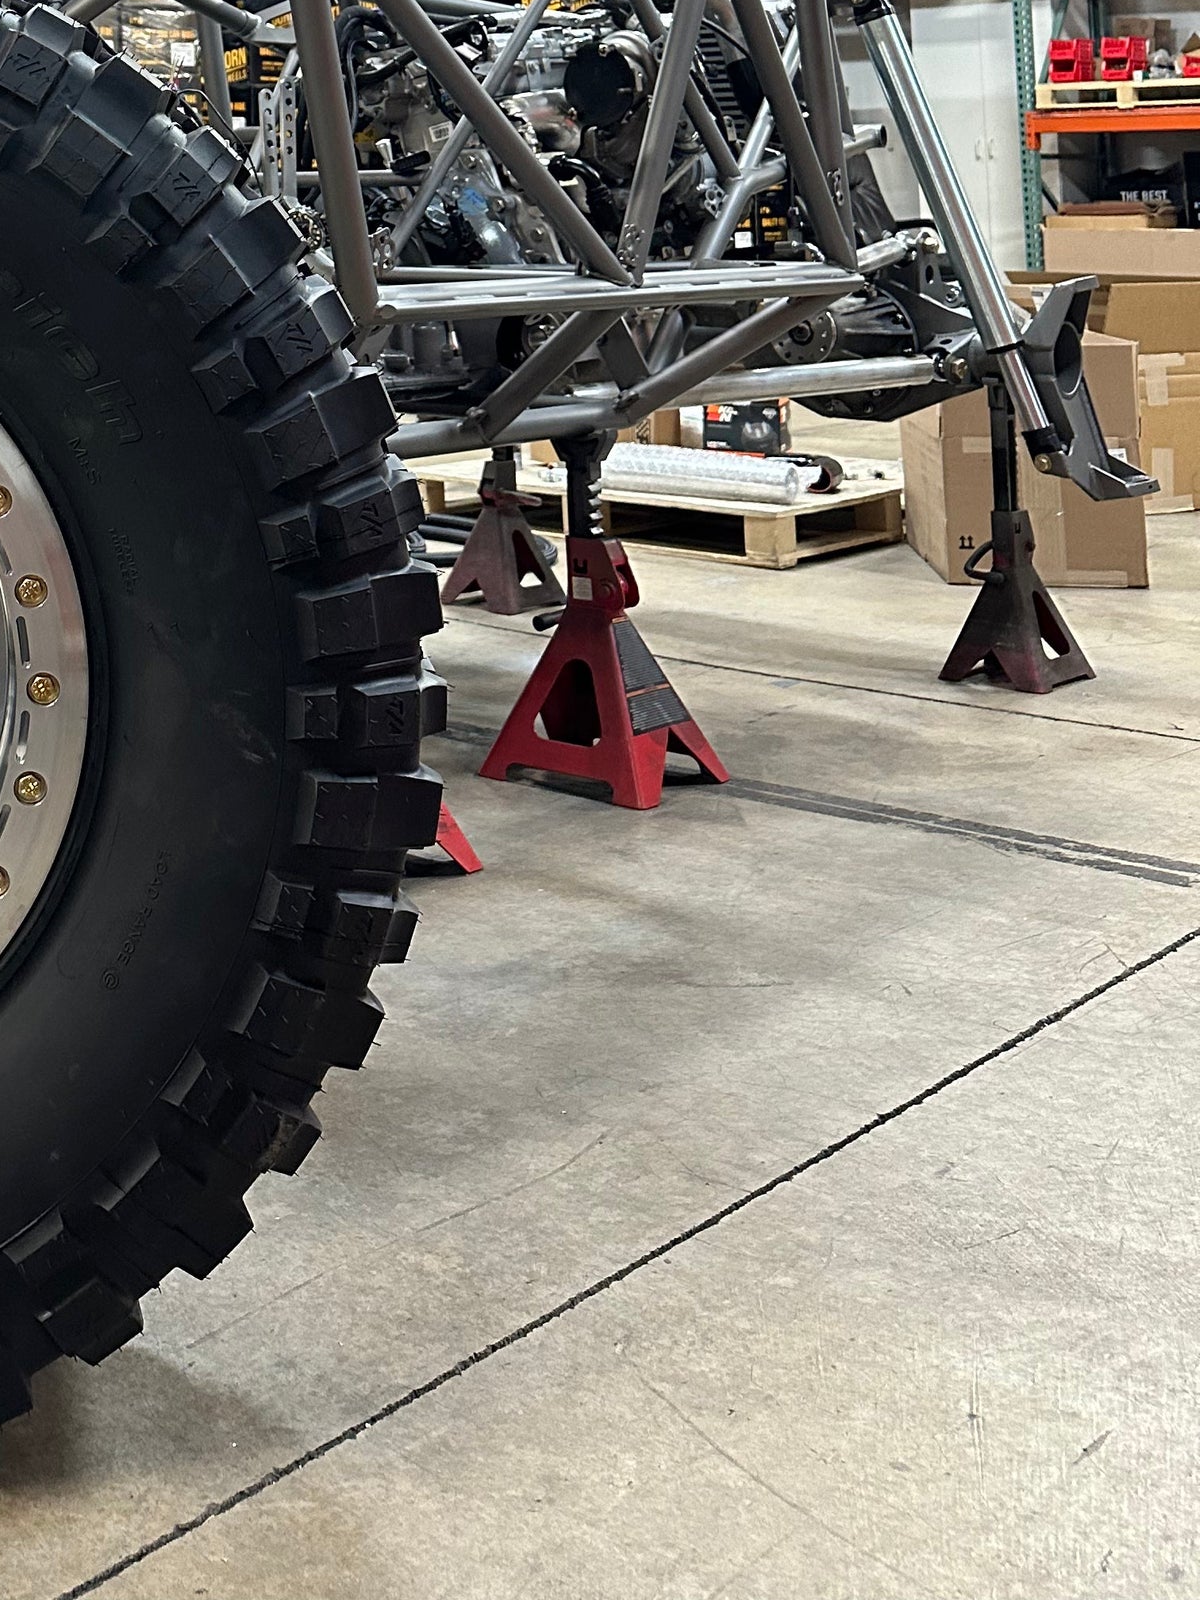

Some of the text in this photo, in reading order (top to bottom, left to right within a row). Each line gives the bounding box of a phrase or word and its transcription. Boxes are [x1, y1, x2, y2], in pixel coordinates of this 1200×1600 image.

[224, 46, 247, 69] ORN
[1120, 189, 1168, 202] THE BEST
